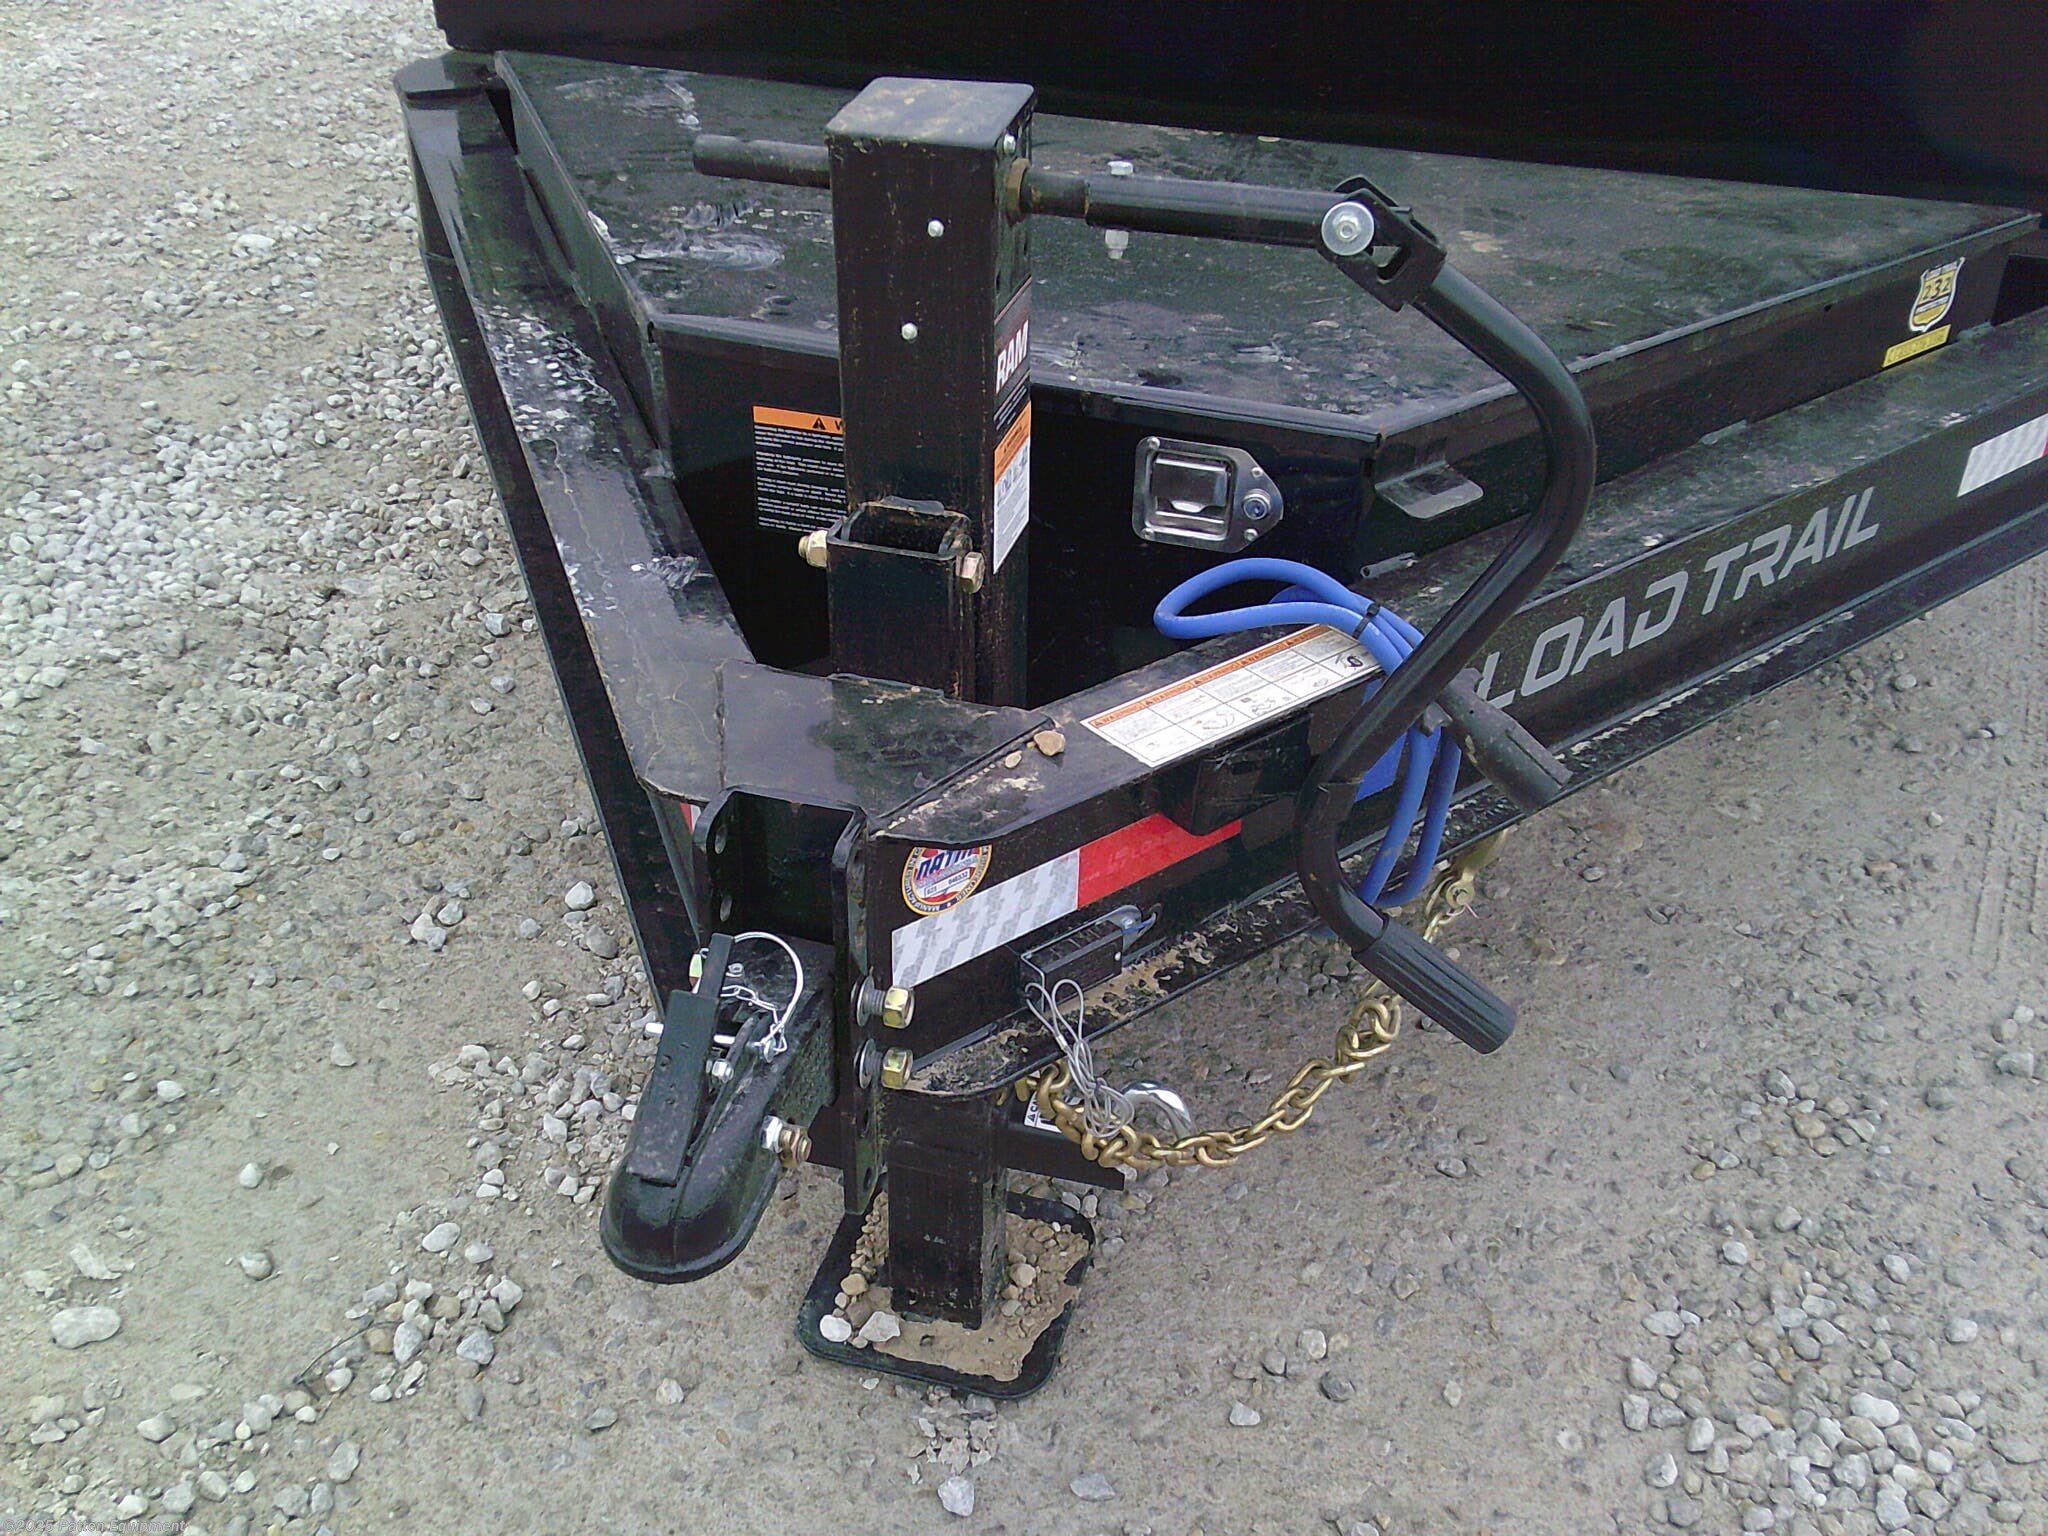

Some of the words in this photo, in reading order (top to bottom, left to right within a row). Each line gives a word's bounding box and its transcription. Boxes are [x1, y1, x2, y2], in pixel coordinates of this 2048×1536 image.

[995, 319, 1029, 395] RAM
[1476, 570, 1689, 709] LOAD
[1701, 486, 1879, 615] TRAIL
